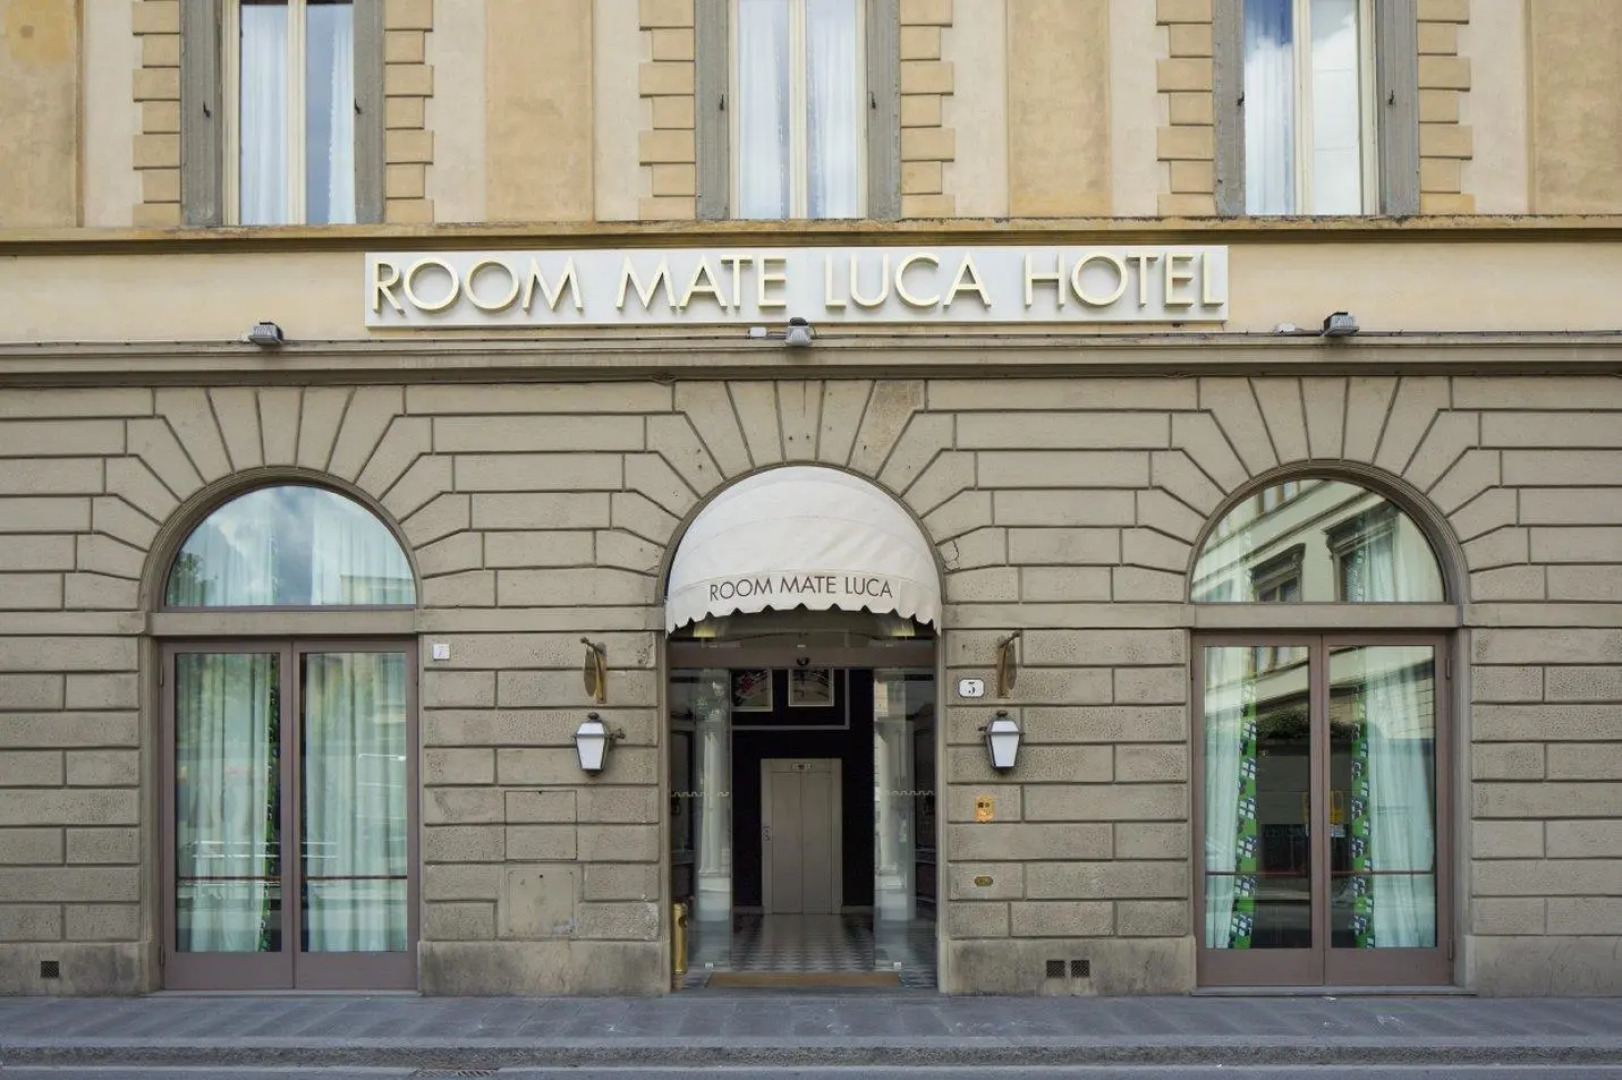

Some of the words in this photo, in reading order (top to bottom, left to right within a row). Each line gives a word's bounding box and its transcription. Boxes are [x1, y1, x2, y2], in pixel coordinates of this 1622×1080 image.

[372, 258, 584, 314] ROOM
[616, 254, 787, 310] MATE
[824, 252, 992, 308] LUCA
[1024, 252, 1226, 308] HOTEL
[709, 578, 773, 601] ROOM
[780, 576, 837, 594] MATE
[845, 577, 893, 598] LUCA
